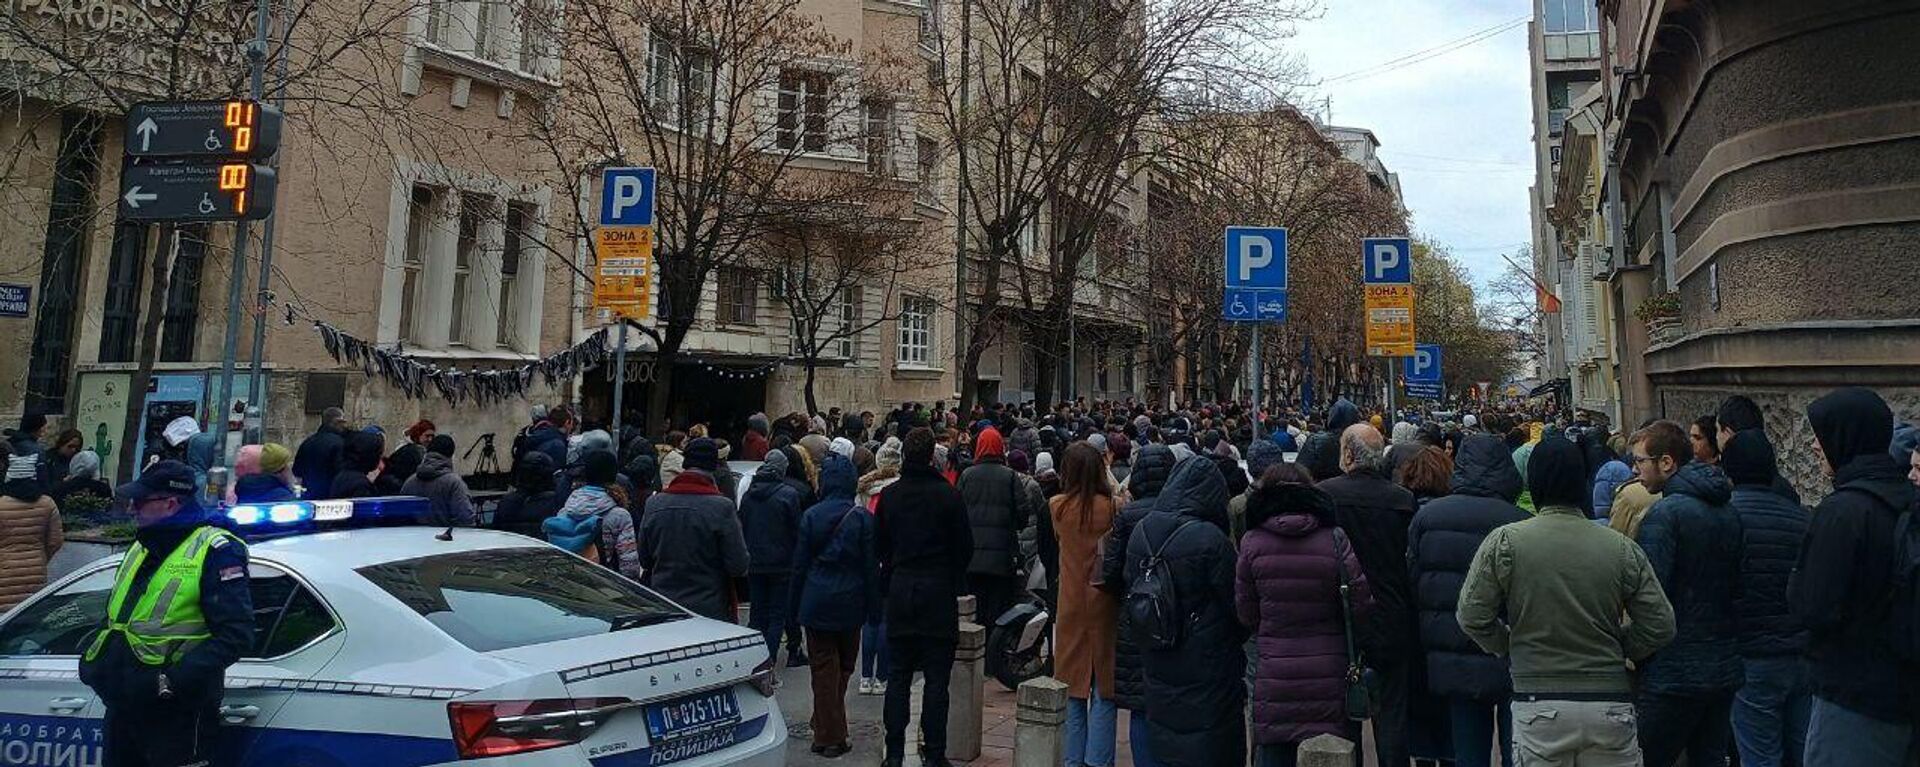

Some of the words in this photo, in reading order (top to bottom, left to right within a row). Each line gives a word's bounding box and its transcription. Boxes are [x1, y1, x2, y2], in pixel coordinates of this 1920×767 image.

[226, 102, 253, 126] 01
[235, 127, 251, 151] 0
[220, 165, 248, 189] 00
[238, 190, 245, 213] 1
[612, 175, 643, 219] P
[603, 231, 636, 241] ЗОНА
[641, 230, 649, 242] 2
[1240, 235, 1272, 280] P
[1374, 244, 1399, 278] P
[1368, 287, 1398, 296] ЗОНА
[1402, 286, 1409, 296] 2
[1413, 351, 1432, 375] P
[650, 731, 735, 765] ПОЛИЦИЈА
